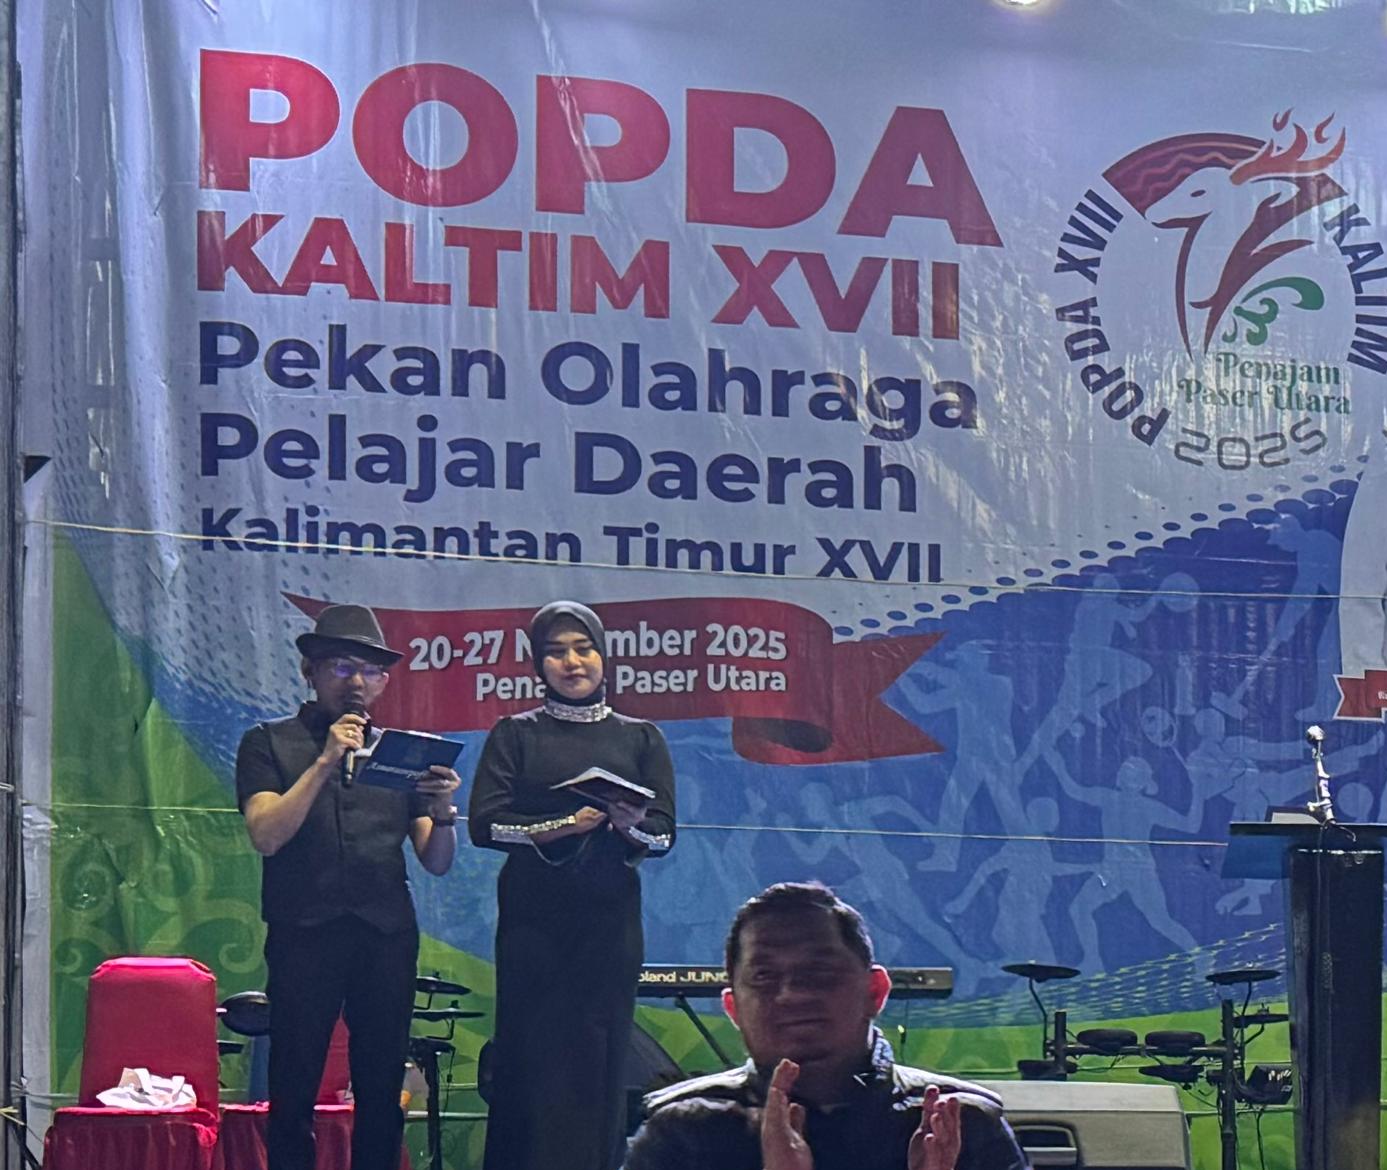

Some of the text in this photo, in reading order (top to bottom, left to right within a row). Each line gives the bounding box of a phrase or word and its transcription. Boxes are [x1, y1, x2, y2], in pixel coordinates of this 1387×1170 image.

[199, 48, 1003, 248] POPDA
[197, 210, 960, 340] KALTIM XVII
[1054, 188, 1172, 446] POPDA XVII
[199, 320, 978, 441] Pekan Olahraga
[1178, 377, 1352, 415] Paser Utara
[1216, 352, 1340, 387] Penajam
[199, 412, 917, 513] Pelajar Daerah
[1174, 417, 1328, 471] 2025
[201, 506, 943, 584] Kalimantan Timur XVII
[408, 621, 787, 671] 20-27 Nmber 2025
[615, 664, 698, 695] Paser
[706, 663, 786, 692] Utara
[638, 970, 677, 983] oland
